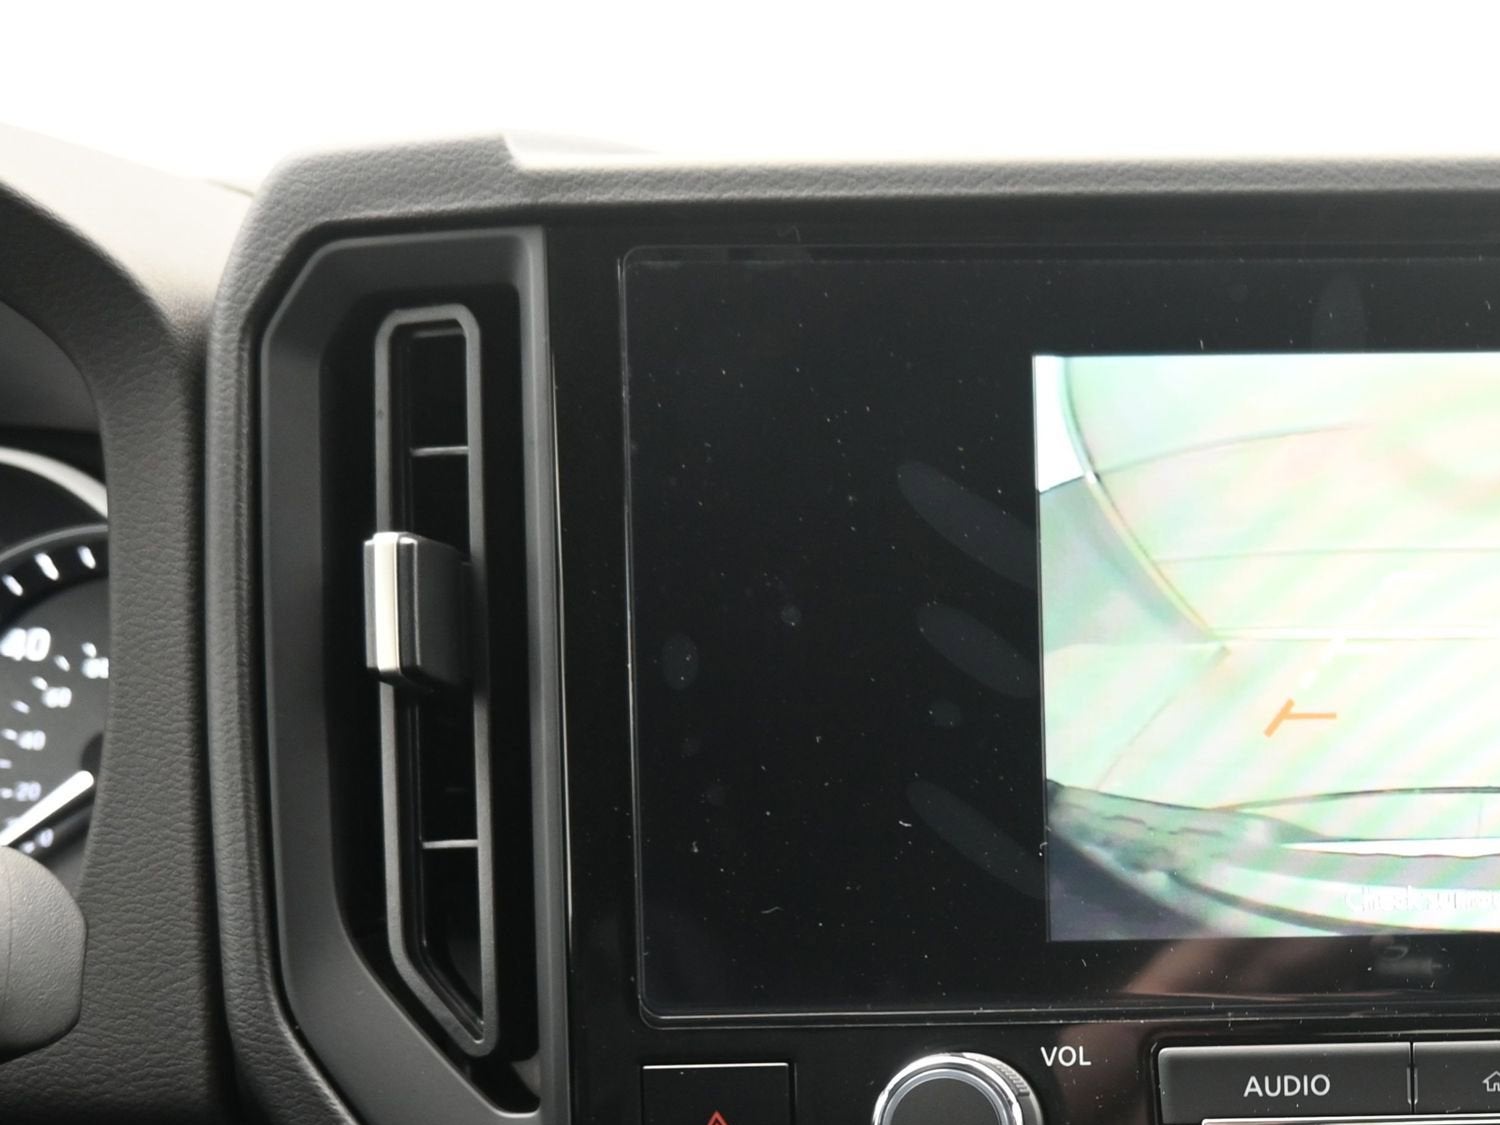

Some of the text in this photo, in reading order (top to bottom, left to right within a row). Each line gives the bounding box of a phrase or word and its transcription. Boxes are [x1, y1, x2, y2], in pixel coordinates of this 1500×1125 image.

[0, 627, 51, 661] 40
[1041, 1046, 1092, 1067] VOL
[1243, 1075, 1331, 1097] AUDIO
